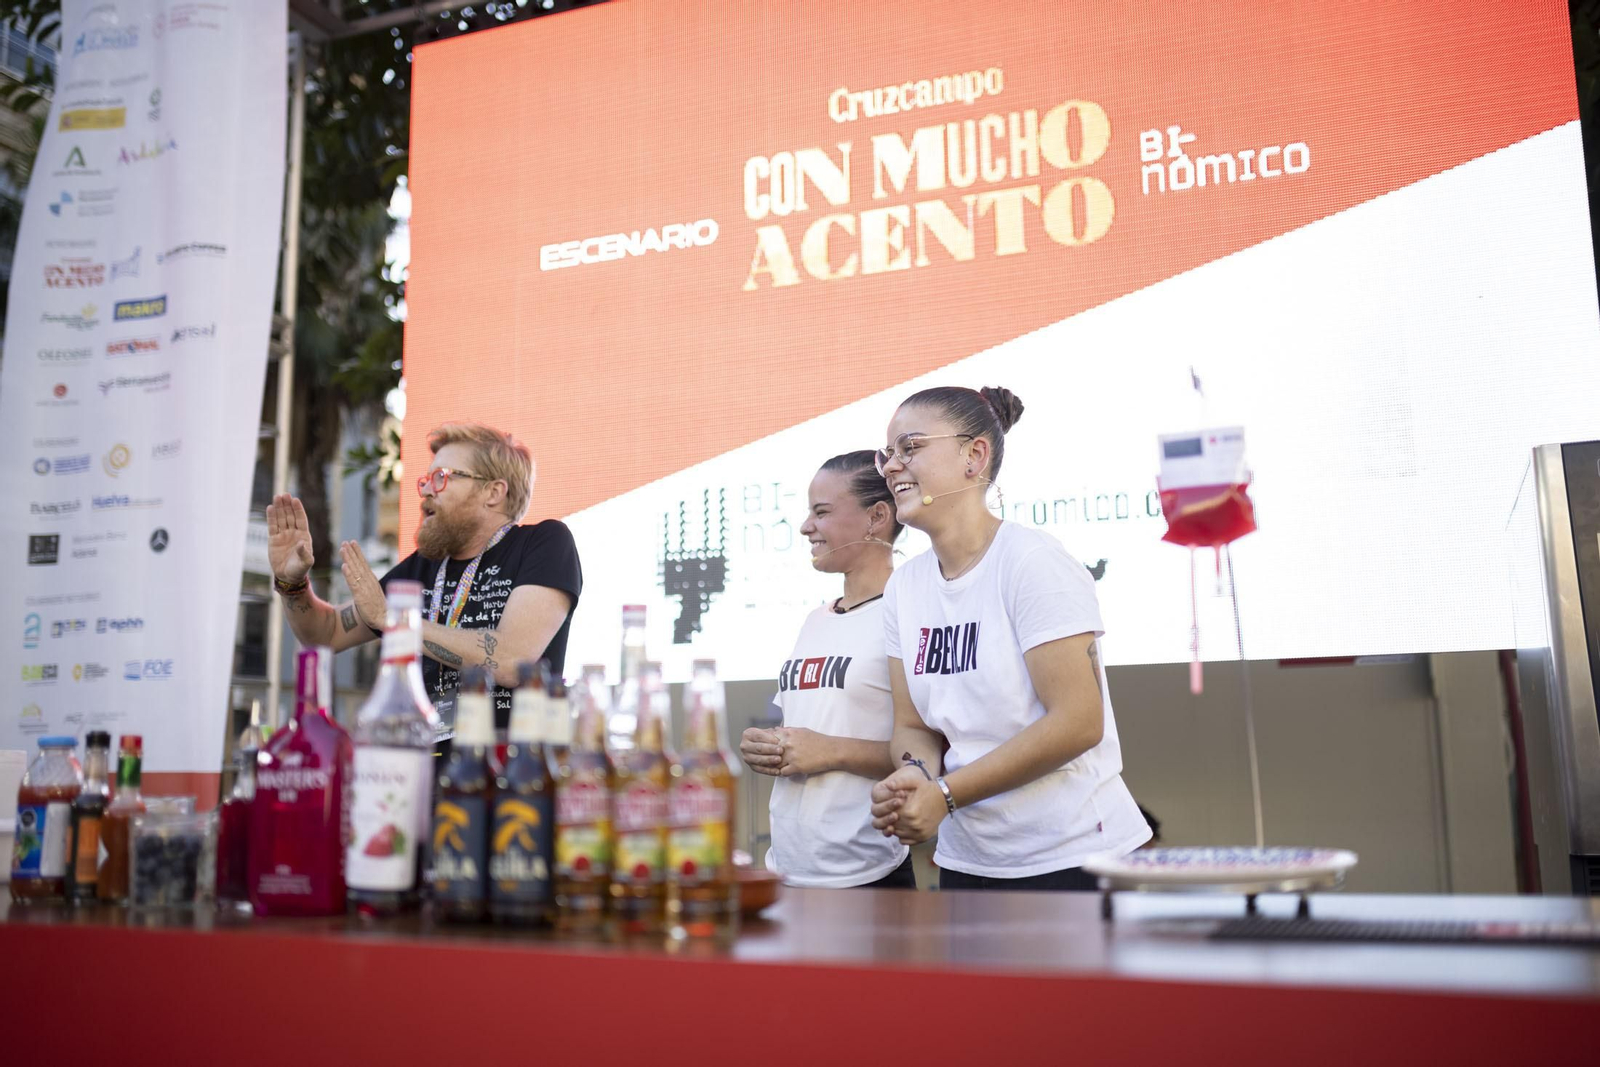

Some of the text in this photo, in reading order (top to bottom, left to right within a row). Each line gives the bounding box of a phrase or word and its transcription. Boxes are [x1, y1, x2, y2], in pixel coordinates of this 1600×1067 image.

[828, 67, 1003, 123] Cruzcampo
[743, 99, 1111, 220] CON MUCHO
[1140, 125, 1197, 162] BI-
[540, 219, 719, 271] ESCENARIO
[742, 176, 1115, 291] ACENTO
[116, 302, 163, 319] makro
[475, 612, 489, 621] de
[779, 656, 853, 693] BERLIN
[496, 700, 511, 709] Sal
